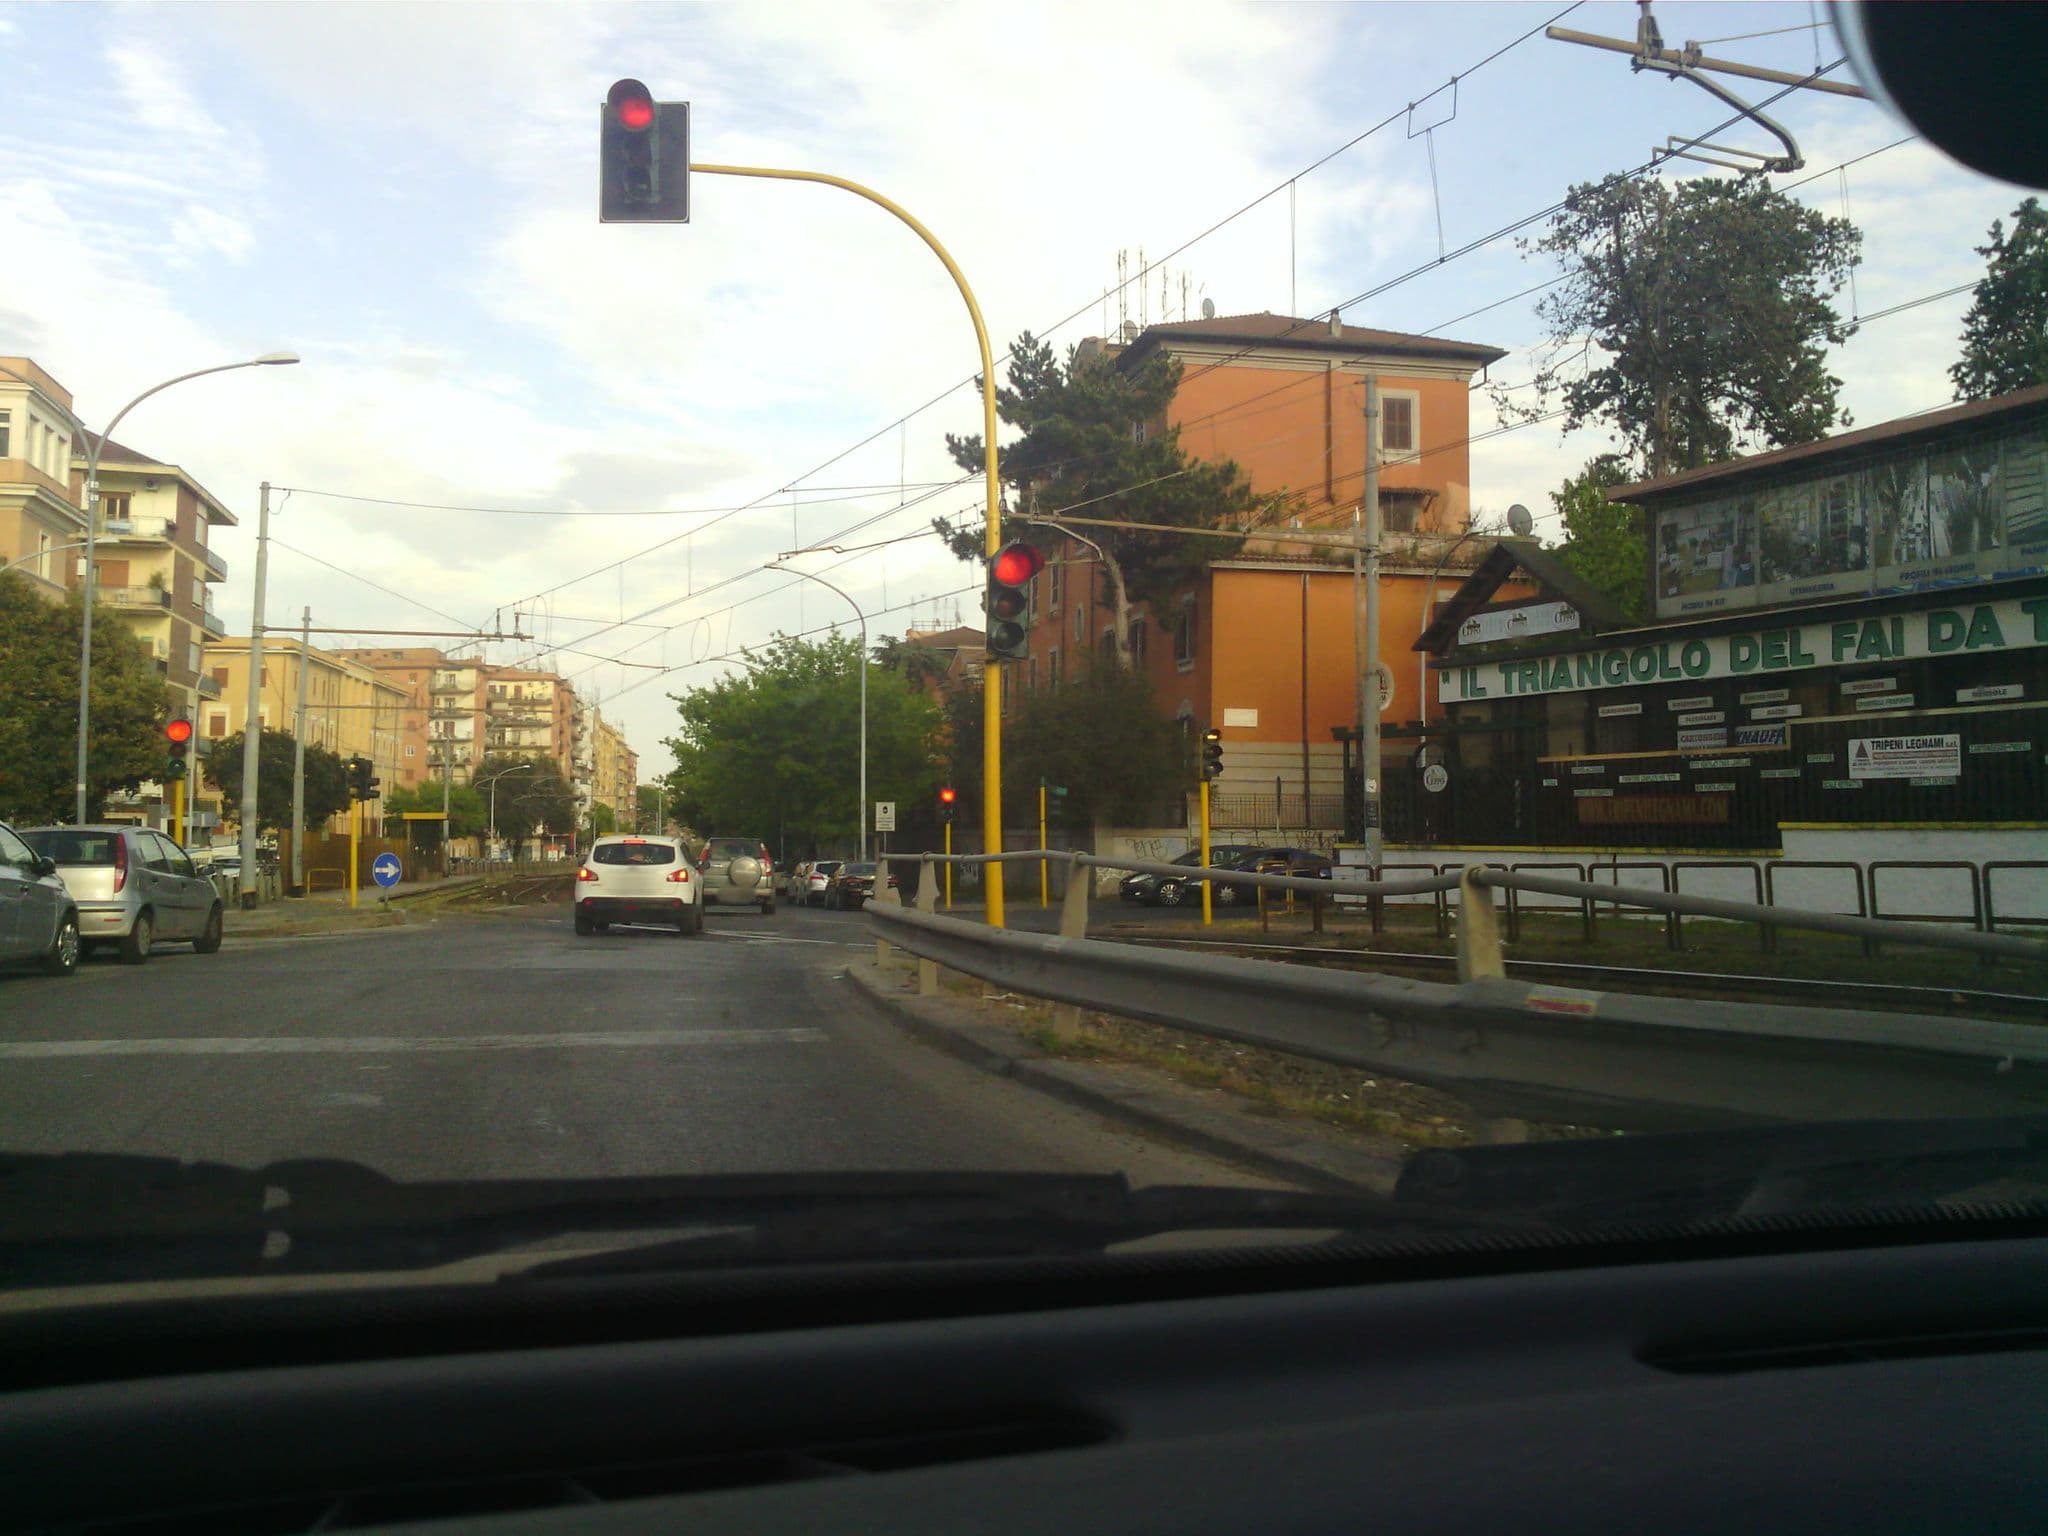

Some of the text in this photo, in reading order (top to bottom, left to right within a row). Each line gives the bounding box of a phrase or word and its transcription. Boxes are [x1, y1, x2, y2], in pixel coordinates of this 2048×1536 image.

[1460, 667, 1487, 699] IL
[1498, 640, 1711, 694] TRIANGOLO
[1730, 629, 1815, 672] DEL
[1832, 616, 1905, 661] FAI
[1928, 605, 2006, 653] DA
[1871, 739, 1903, 750] TRIPENI
[1905, 736, 1944, 749] LEGNAMI
